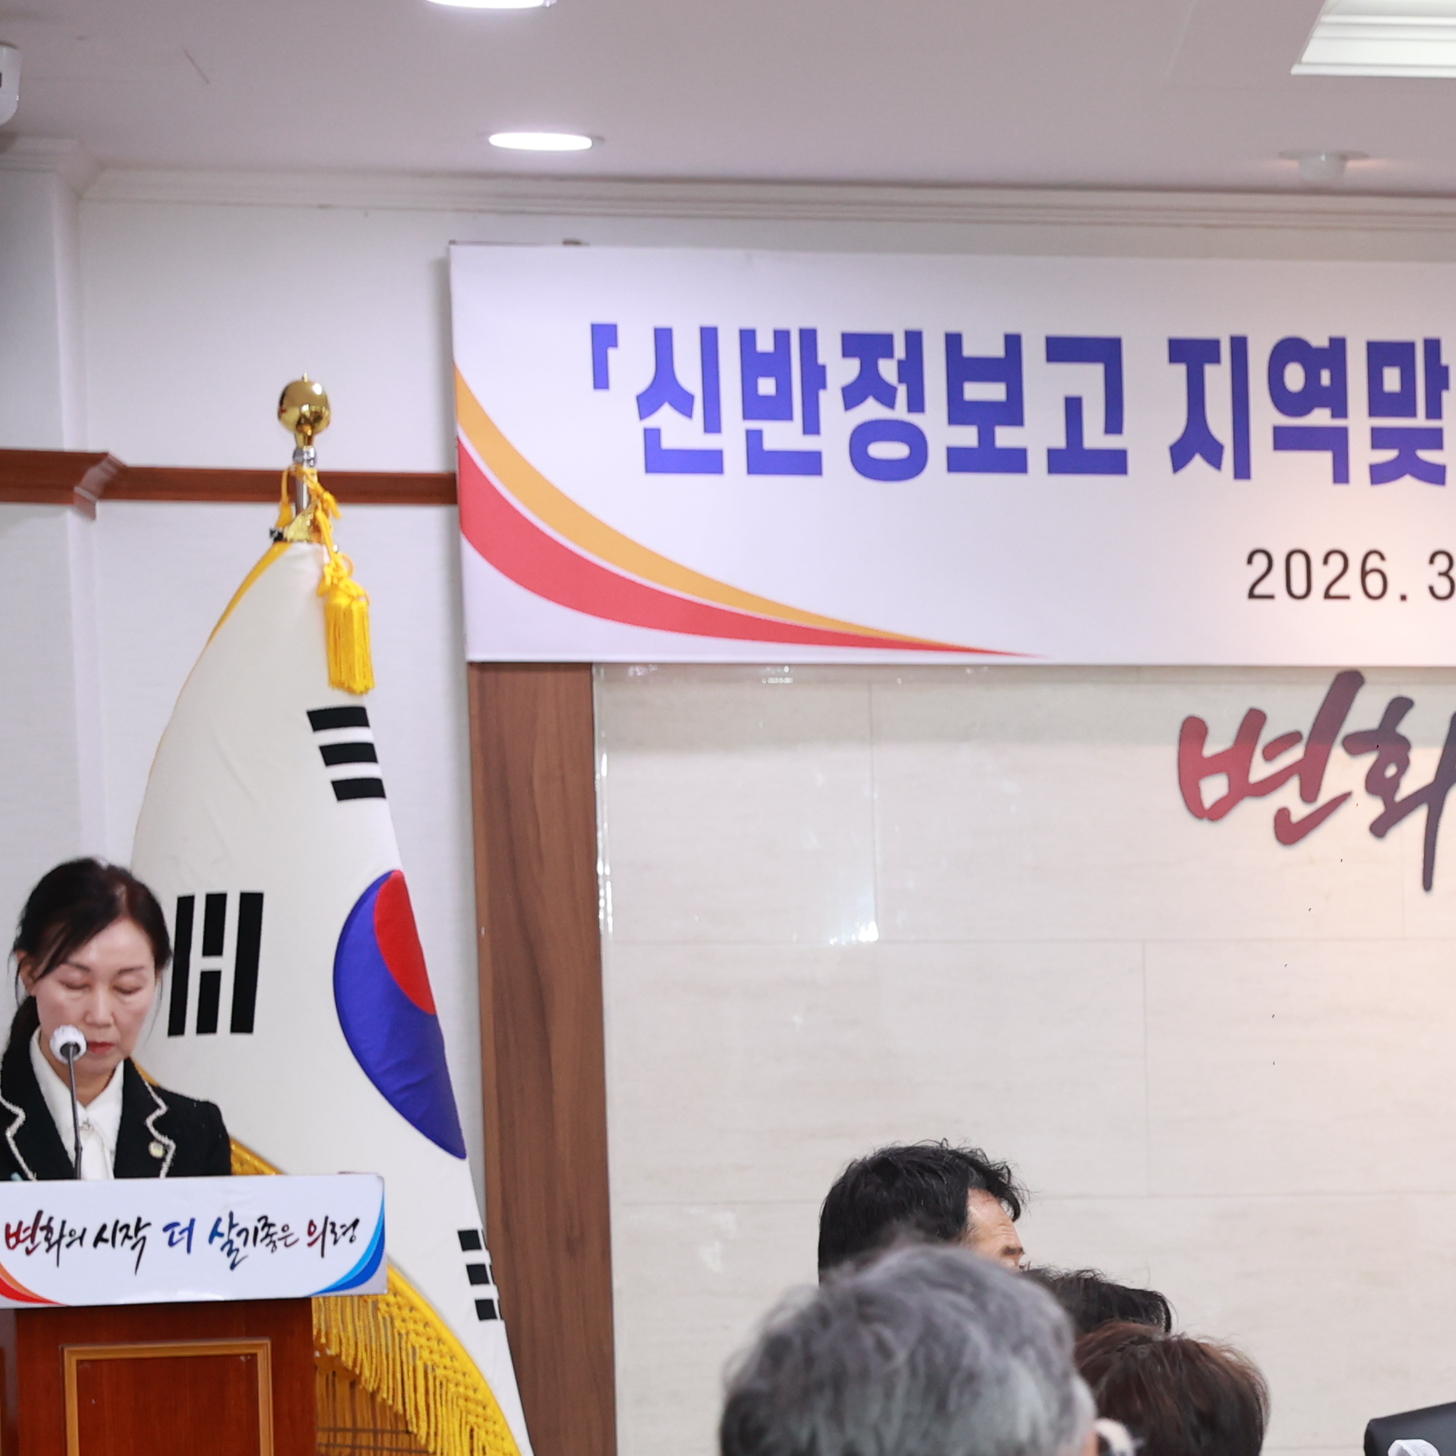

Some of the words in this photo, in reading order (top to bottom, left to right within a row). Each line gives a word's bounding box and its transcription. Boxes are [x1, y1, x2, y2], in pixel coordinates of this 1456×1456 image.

[592, 324, 1128, 482] 「신반정보고
[3, 1208, 87, 1267] 변화의
[92, 1215, 152, 1275] 시작
[162, 1216, 196, 1255] 더
[208, 1210, 299, 1271] 살기좋은
[306, 1214, 361, 1258] 의령
